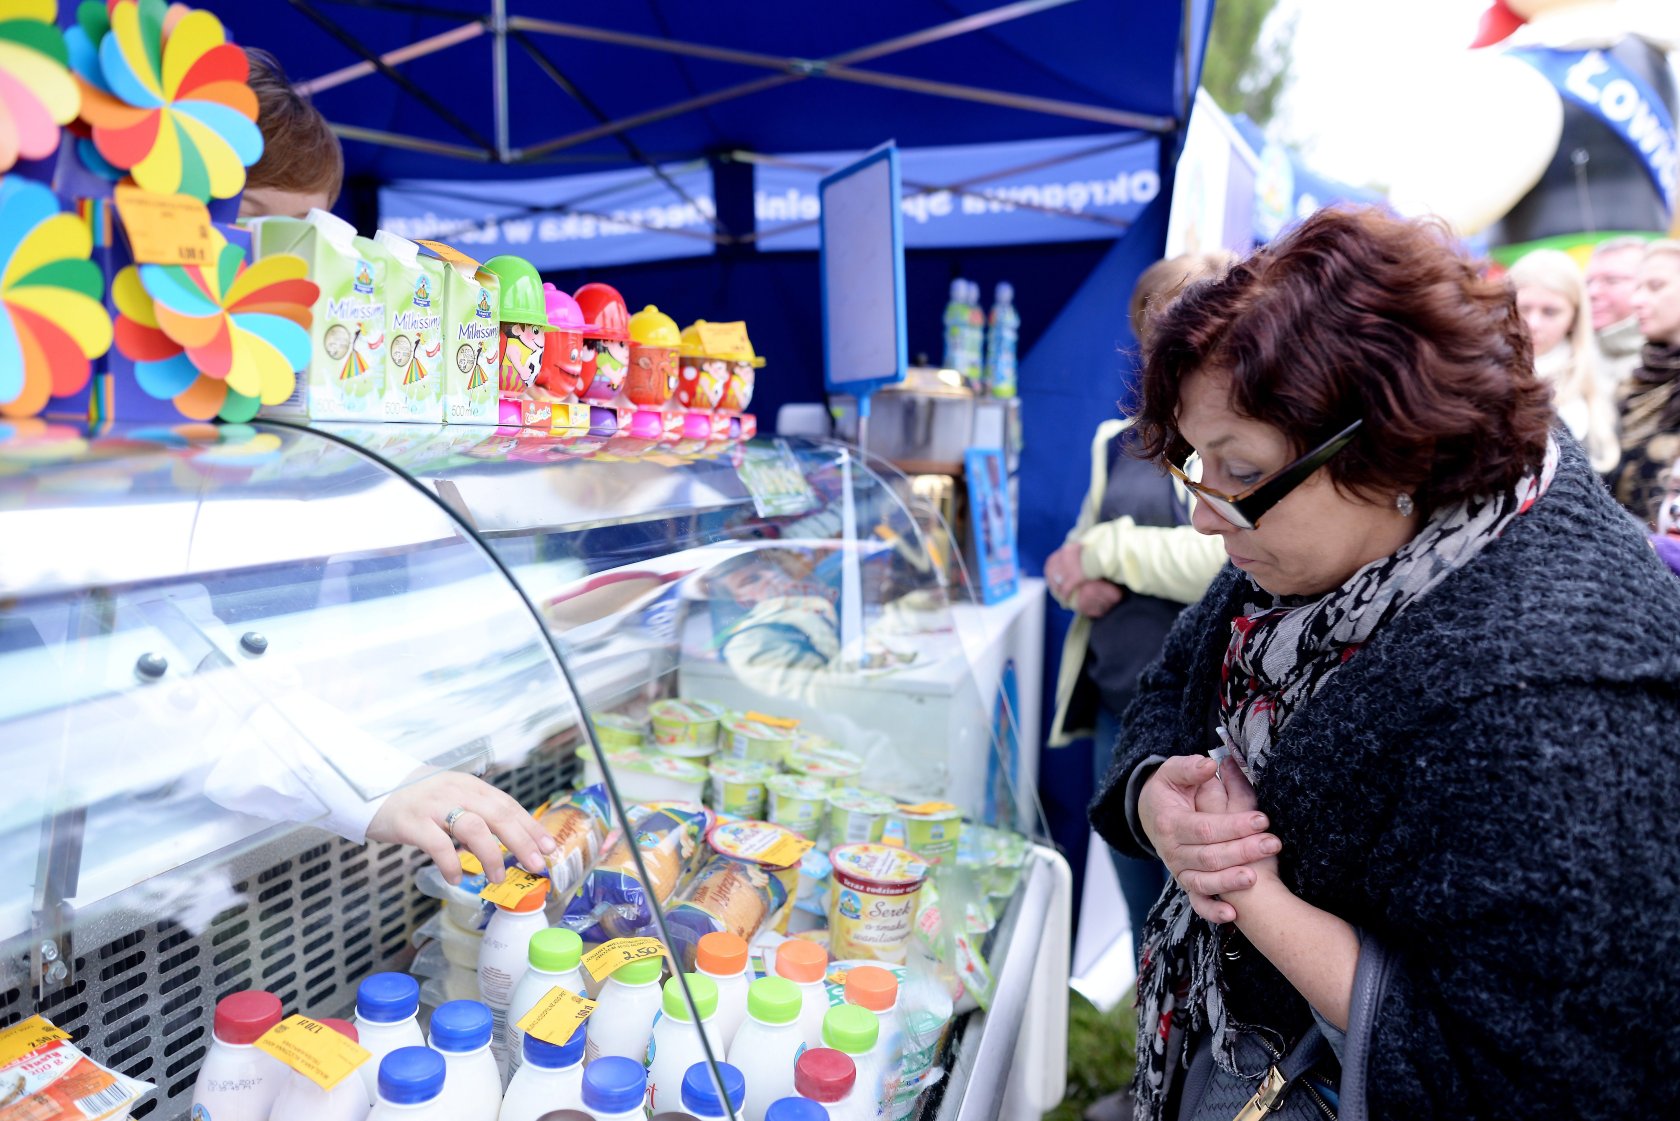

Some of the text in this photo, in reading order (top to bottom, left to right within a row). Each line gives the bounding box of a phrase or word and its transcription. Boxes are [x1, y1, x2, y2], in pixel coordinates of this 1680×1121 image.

[327, 298, 385, 320] Milkissim
[869, 899, 911, 918] Serek
[622, 946, 658, 961] 2,50
